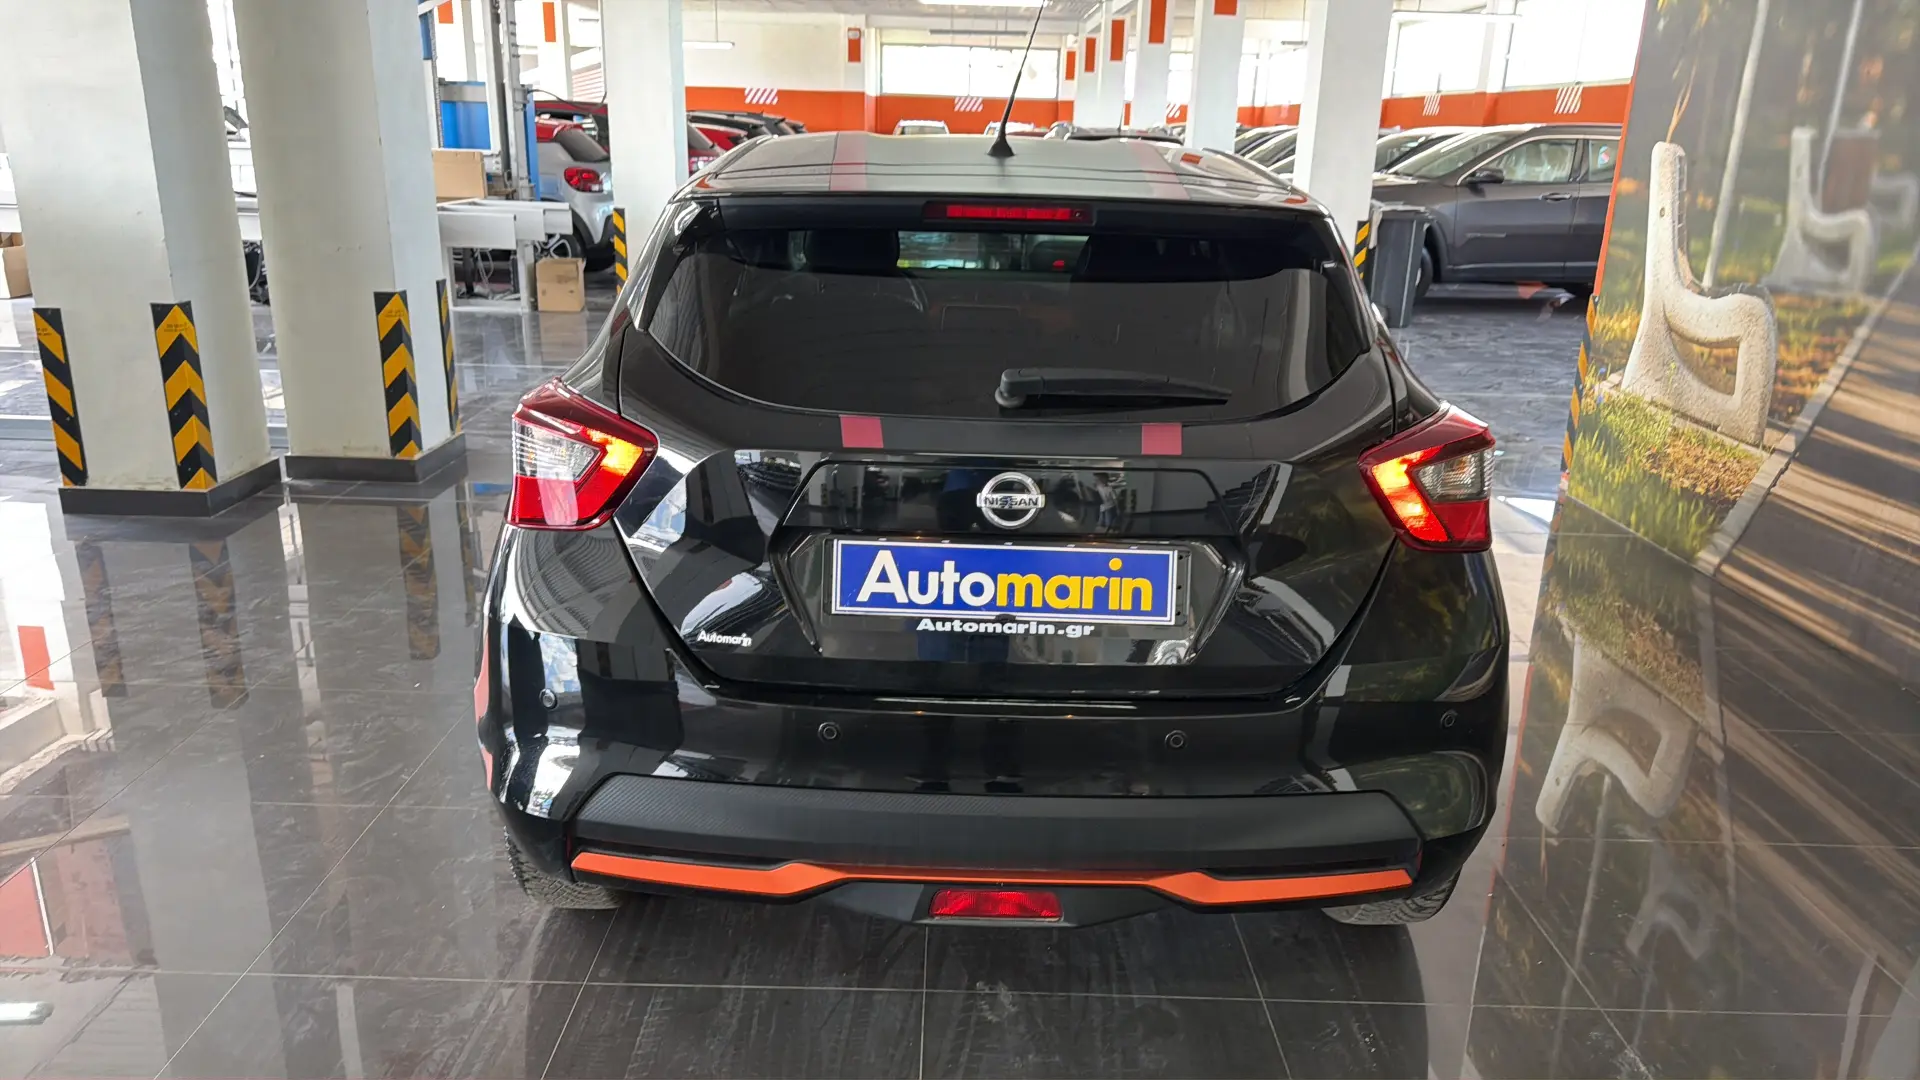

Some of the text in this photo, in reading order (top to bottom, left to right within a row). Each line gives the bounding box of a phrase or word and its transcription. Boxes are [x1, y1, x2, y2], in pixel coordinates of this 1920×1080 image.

[984, 496, 1039, 507] NISSAN
[855, 549, 1153, 611] Automarin
[916, 618, 1095, 638] Automarin.gr
[697, 629, 752, 647] Automarin
